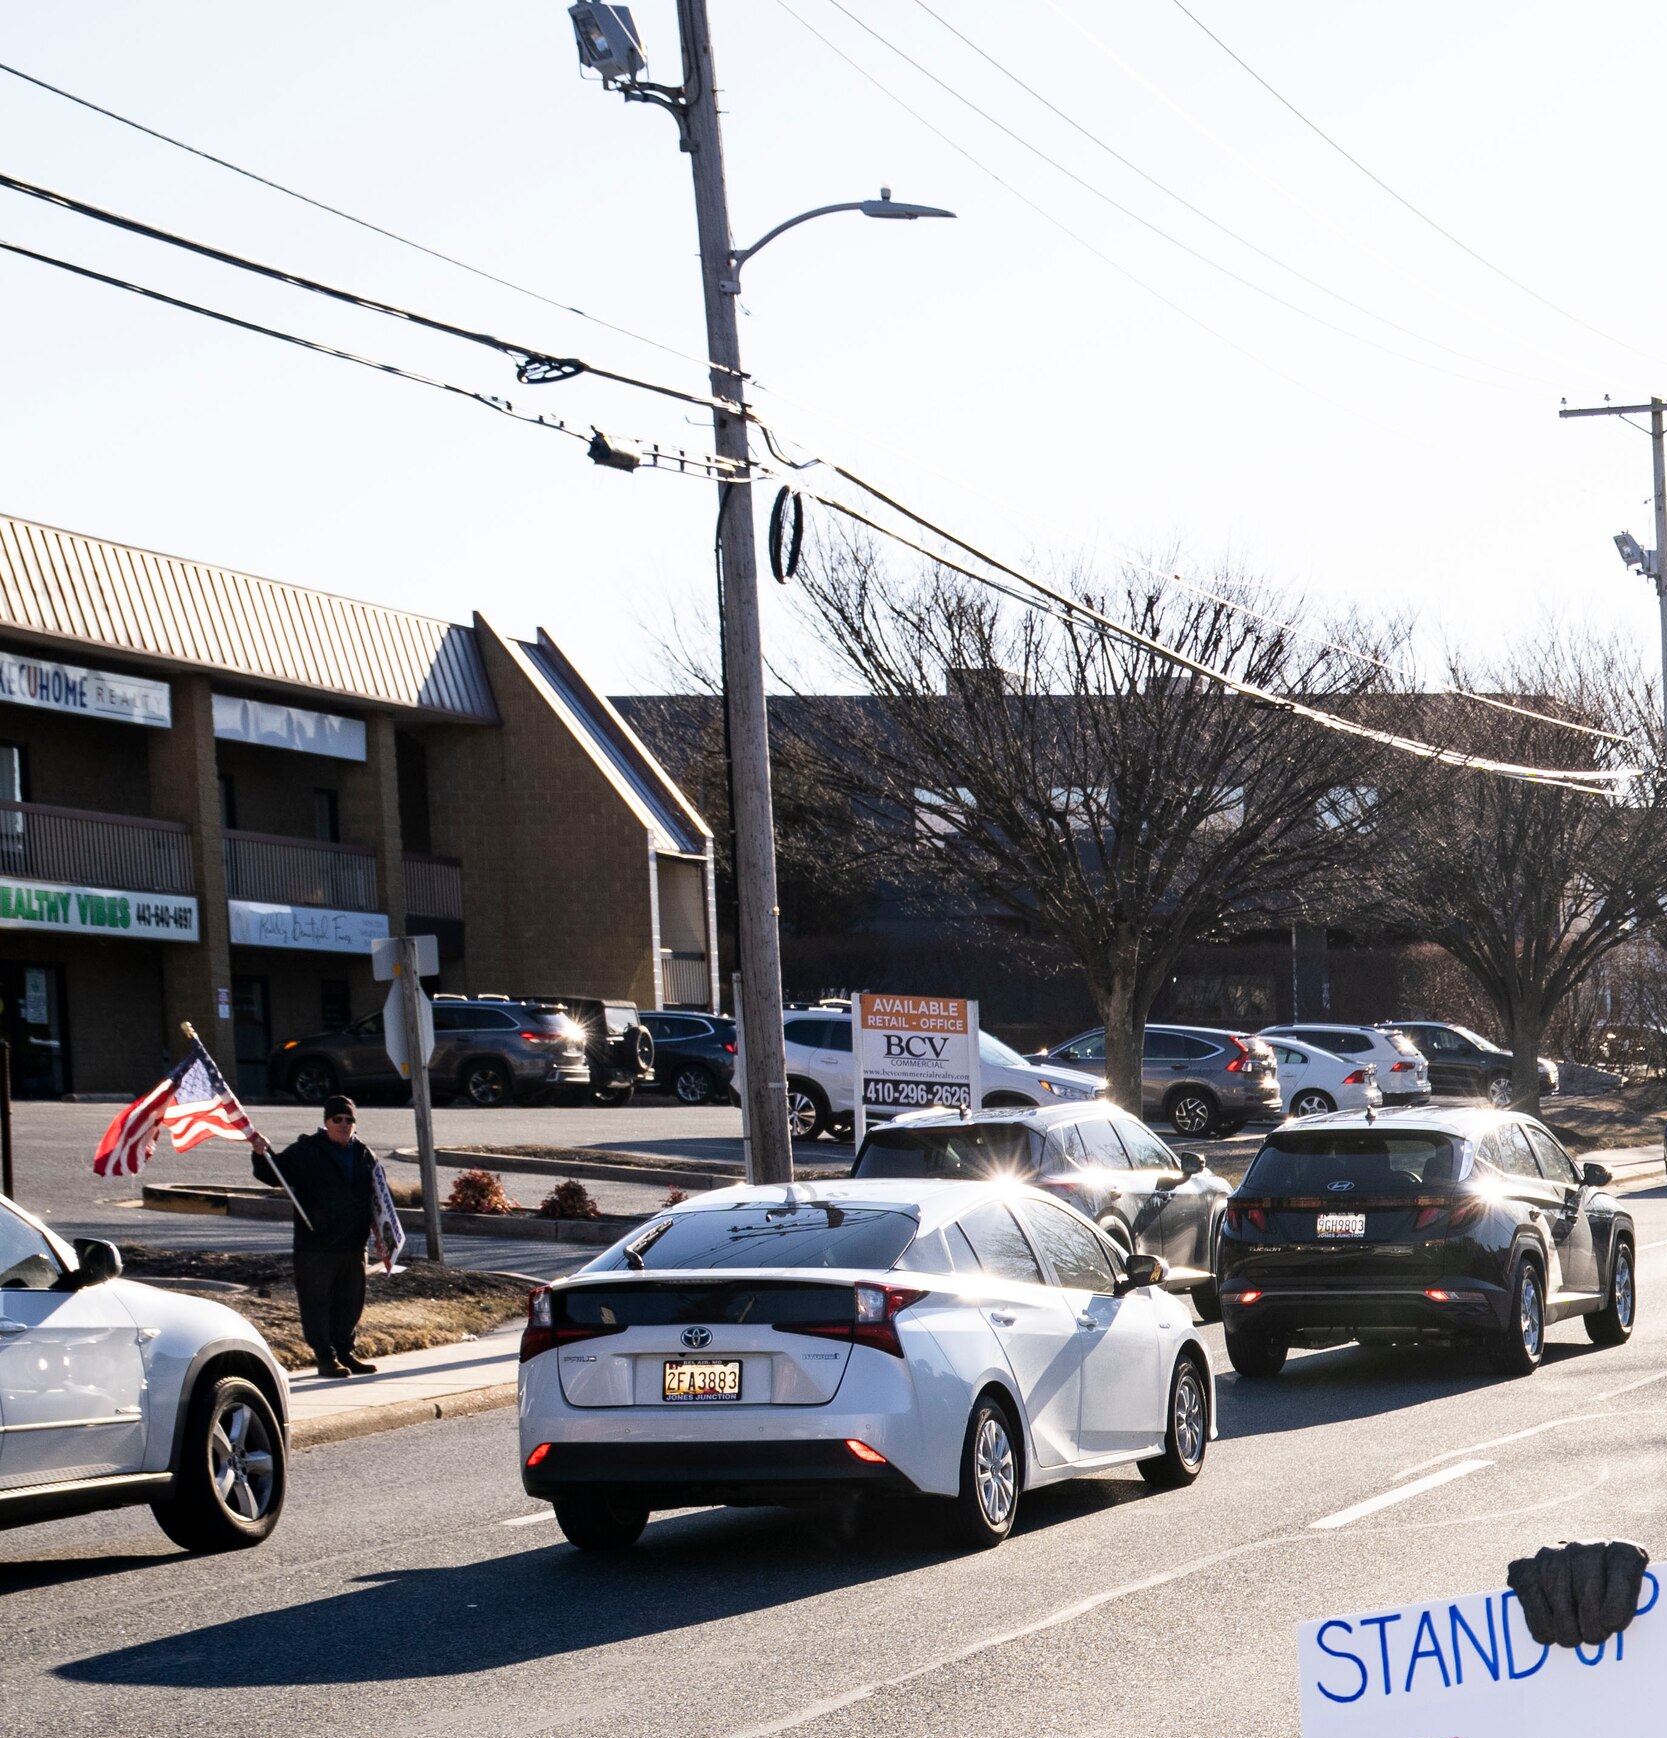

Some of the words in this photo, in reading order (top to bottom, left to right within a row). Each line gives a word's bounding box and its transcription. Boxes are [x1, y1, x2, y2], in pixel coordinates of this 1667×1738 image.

[75, 893, 131, 929] VIBES
[873, 998, 958, 1016] AVAILABLE
[867, 1015, 909, 1028] RETAIL
[920, 1018, 964, 1031] OFFICE
[883, 1034, 950, 1058] BCV
[891, 1059, 945, 1069] COMMERCIAL
[866, 1081, 970, 1105] 410-296-2626
[1318, 1219, 1364, 1232] 9GH9803
[667, 1371, 738, 1391] 2FA3883
[1315, 1588, 1550, 1703] STAND
